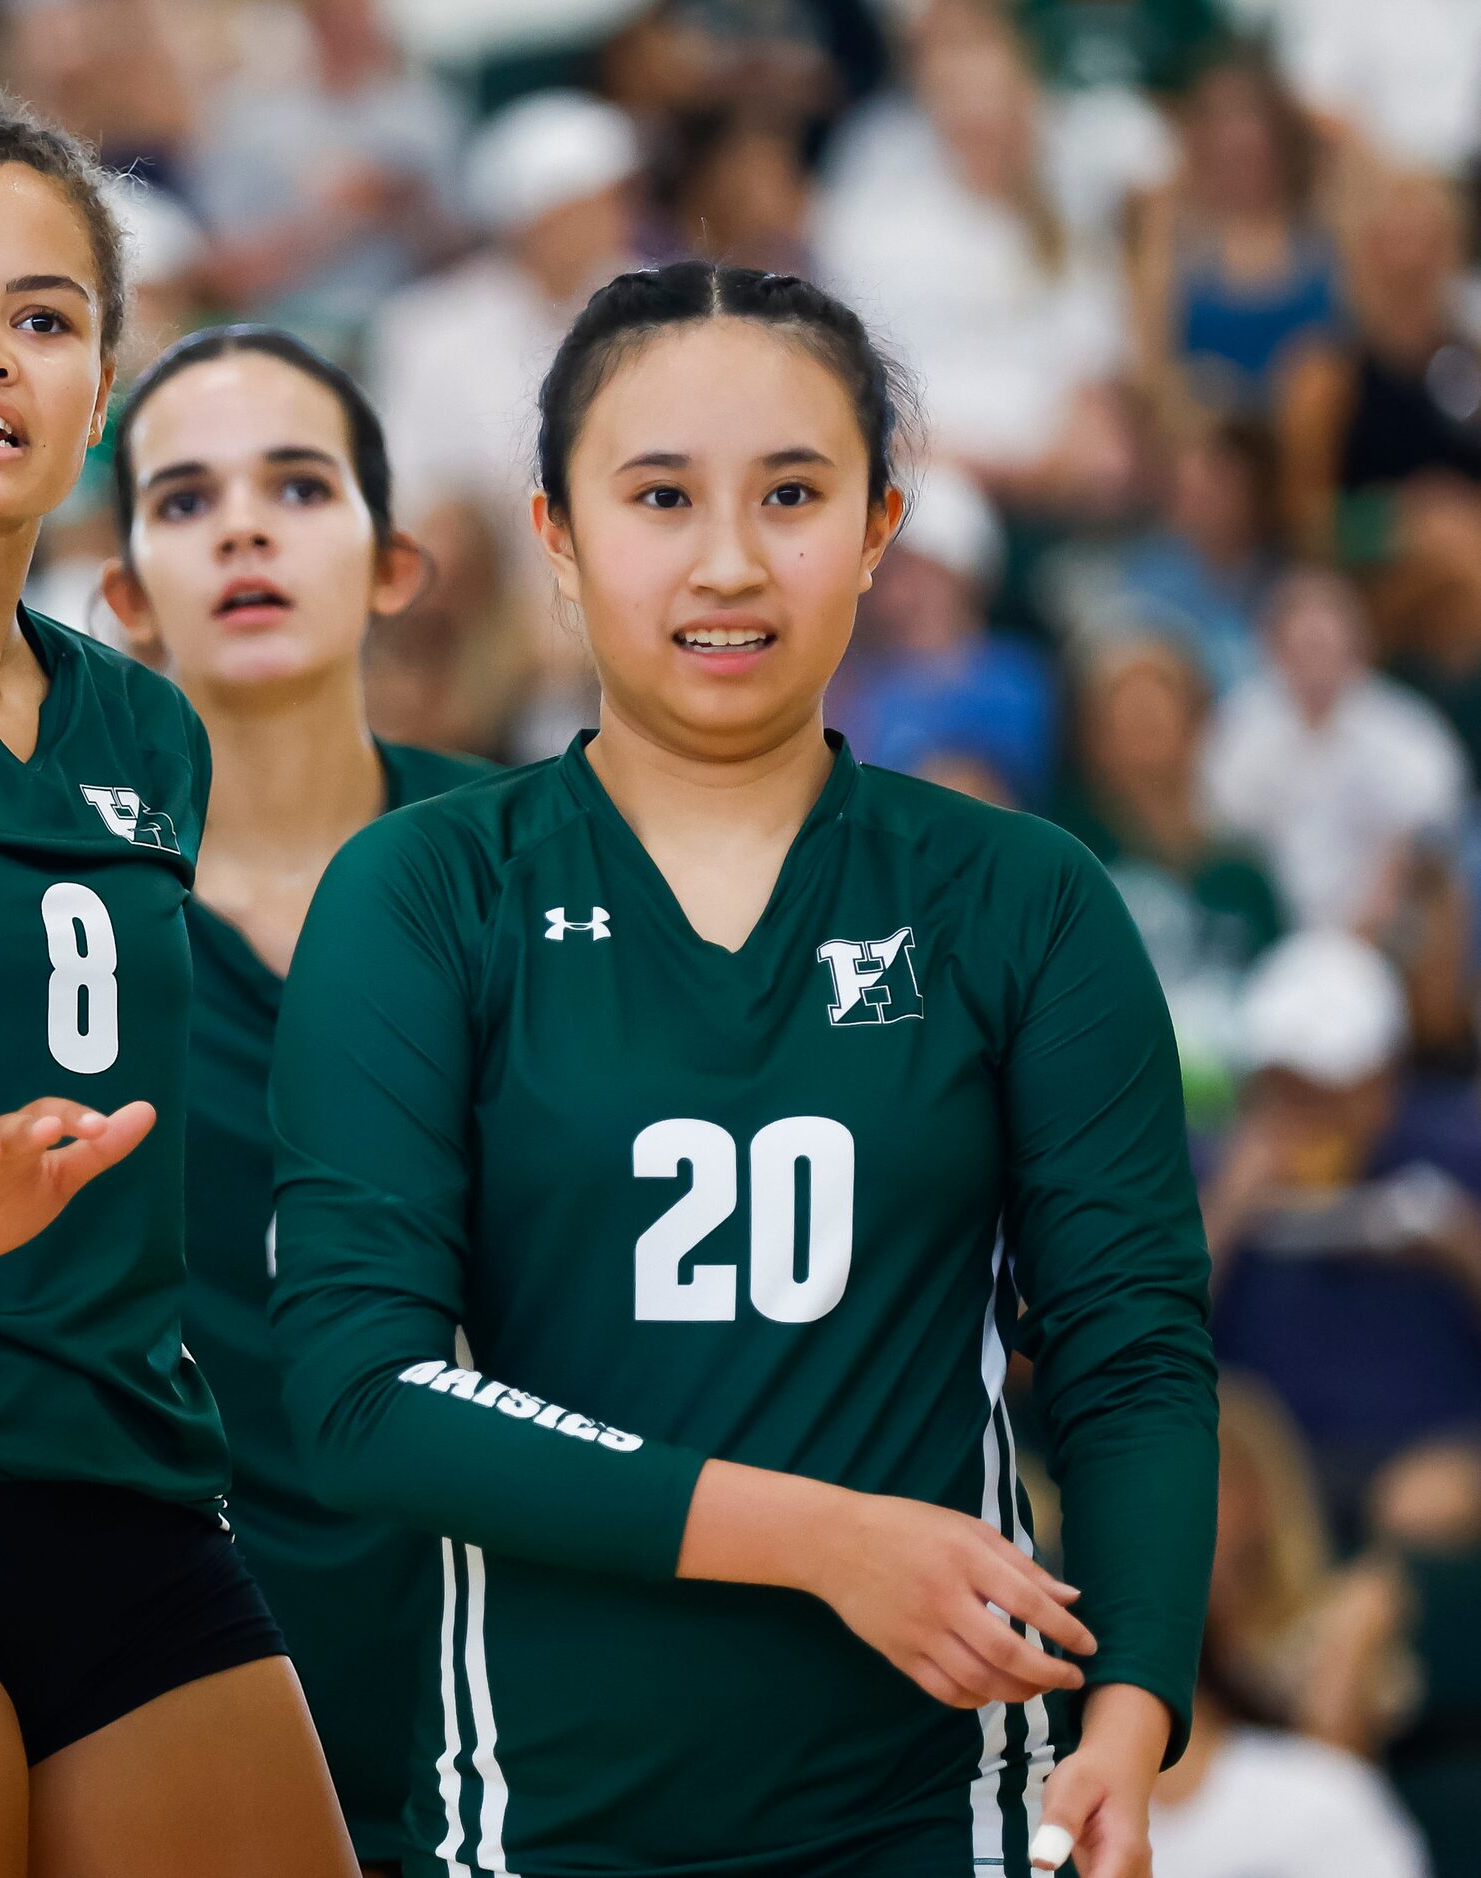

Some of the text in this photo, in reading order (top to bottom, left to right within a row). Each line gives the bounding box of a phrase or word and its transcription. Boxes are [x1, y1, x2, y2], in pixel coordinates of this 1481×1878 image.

[41, 882, 118, 1074] 8
[817, 926, 924, 1026] H
[633, 1116, 855, 1323] 20
[398, 1360, 644, 1452] DAISIES
